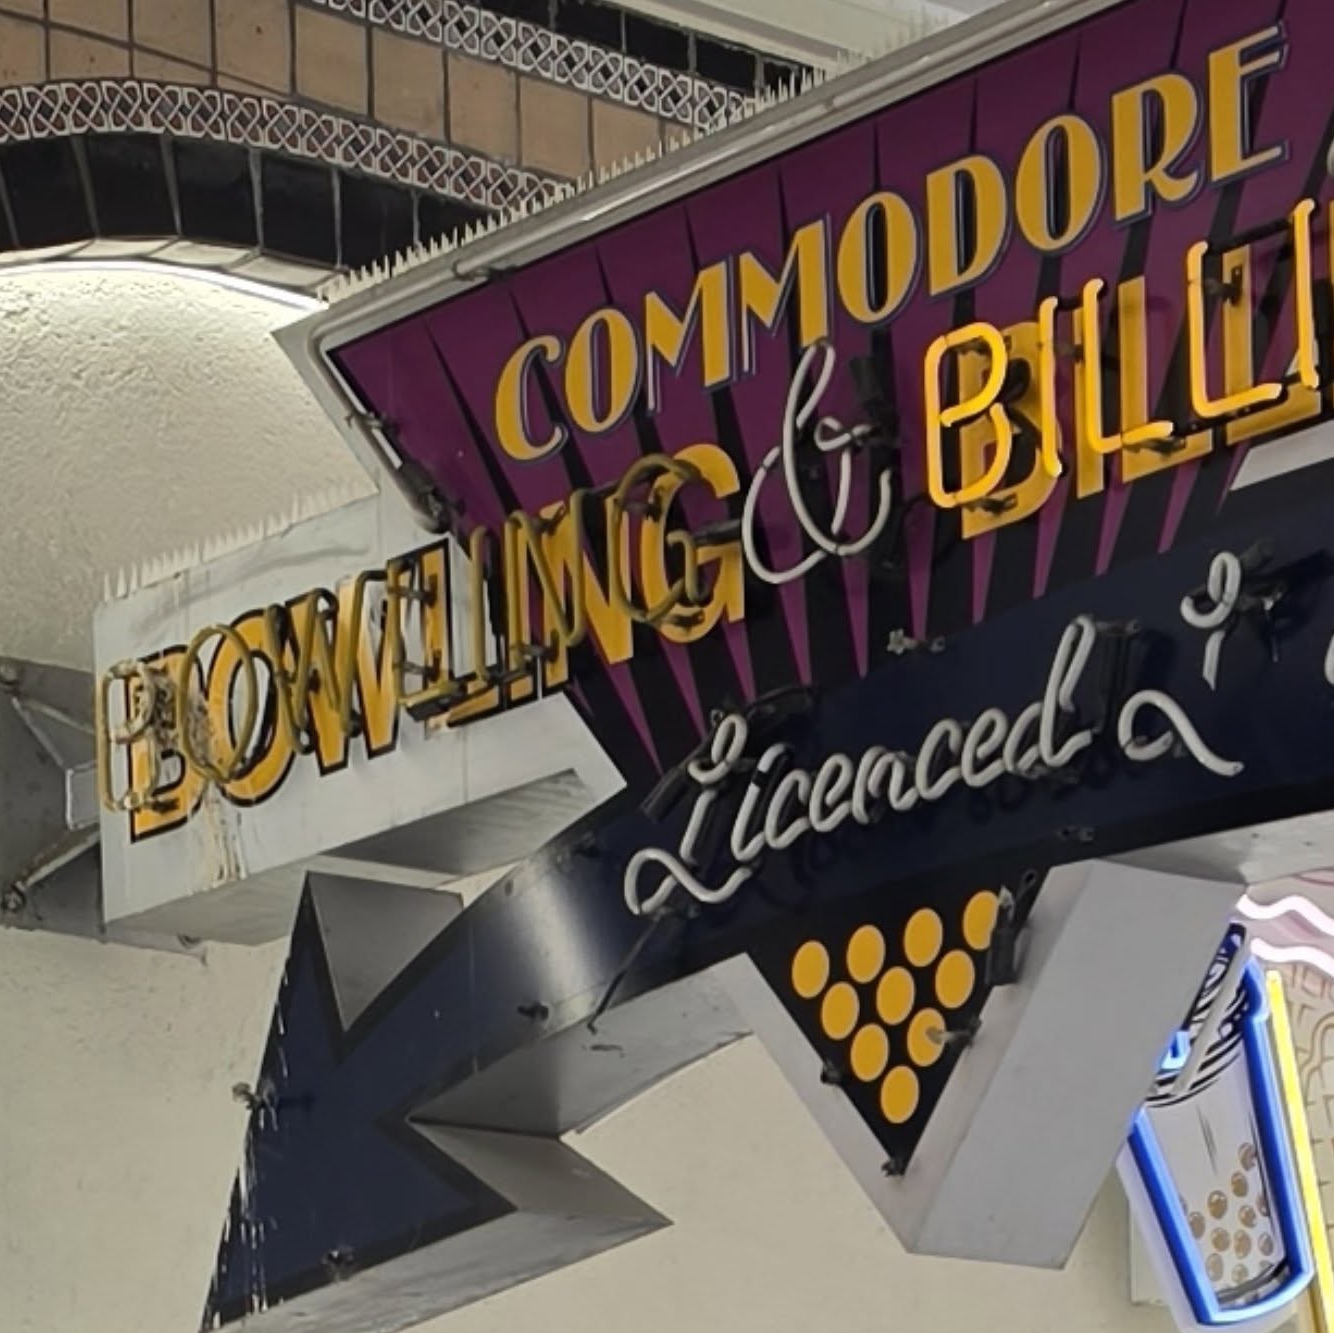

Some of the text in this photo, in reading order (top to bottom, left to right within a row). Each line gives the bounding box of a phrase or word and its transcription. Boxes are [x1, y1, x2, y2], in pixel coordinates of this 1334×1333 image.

[494, 20, 1289, 465] COMMODORE
[100, 442, 747, 844] BOWLING
[742, 337, 894, 584] &
[623, 614, 1094, 917] Licenced
